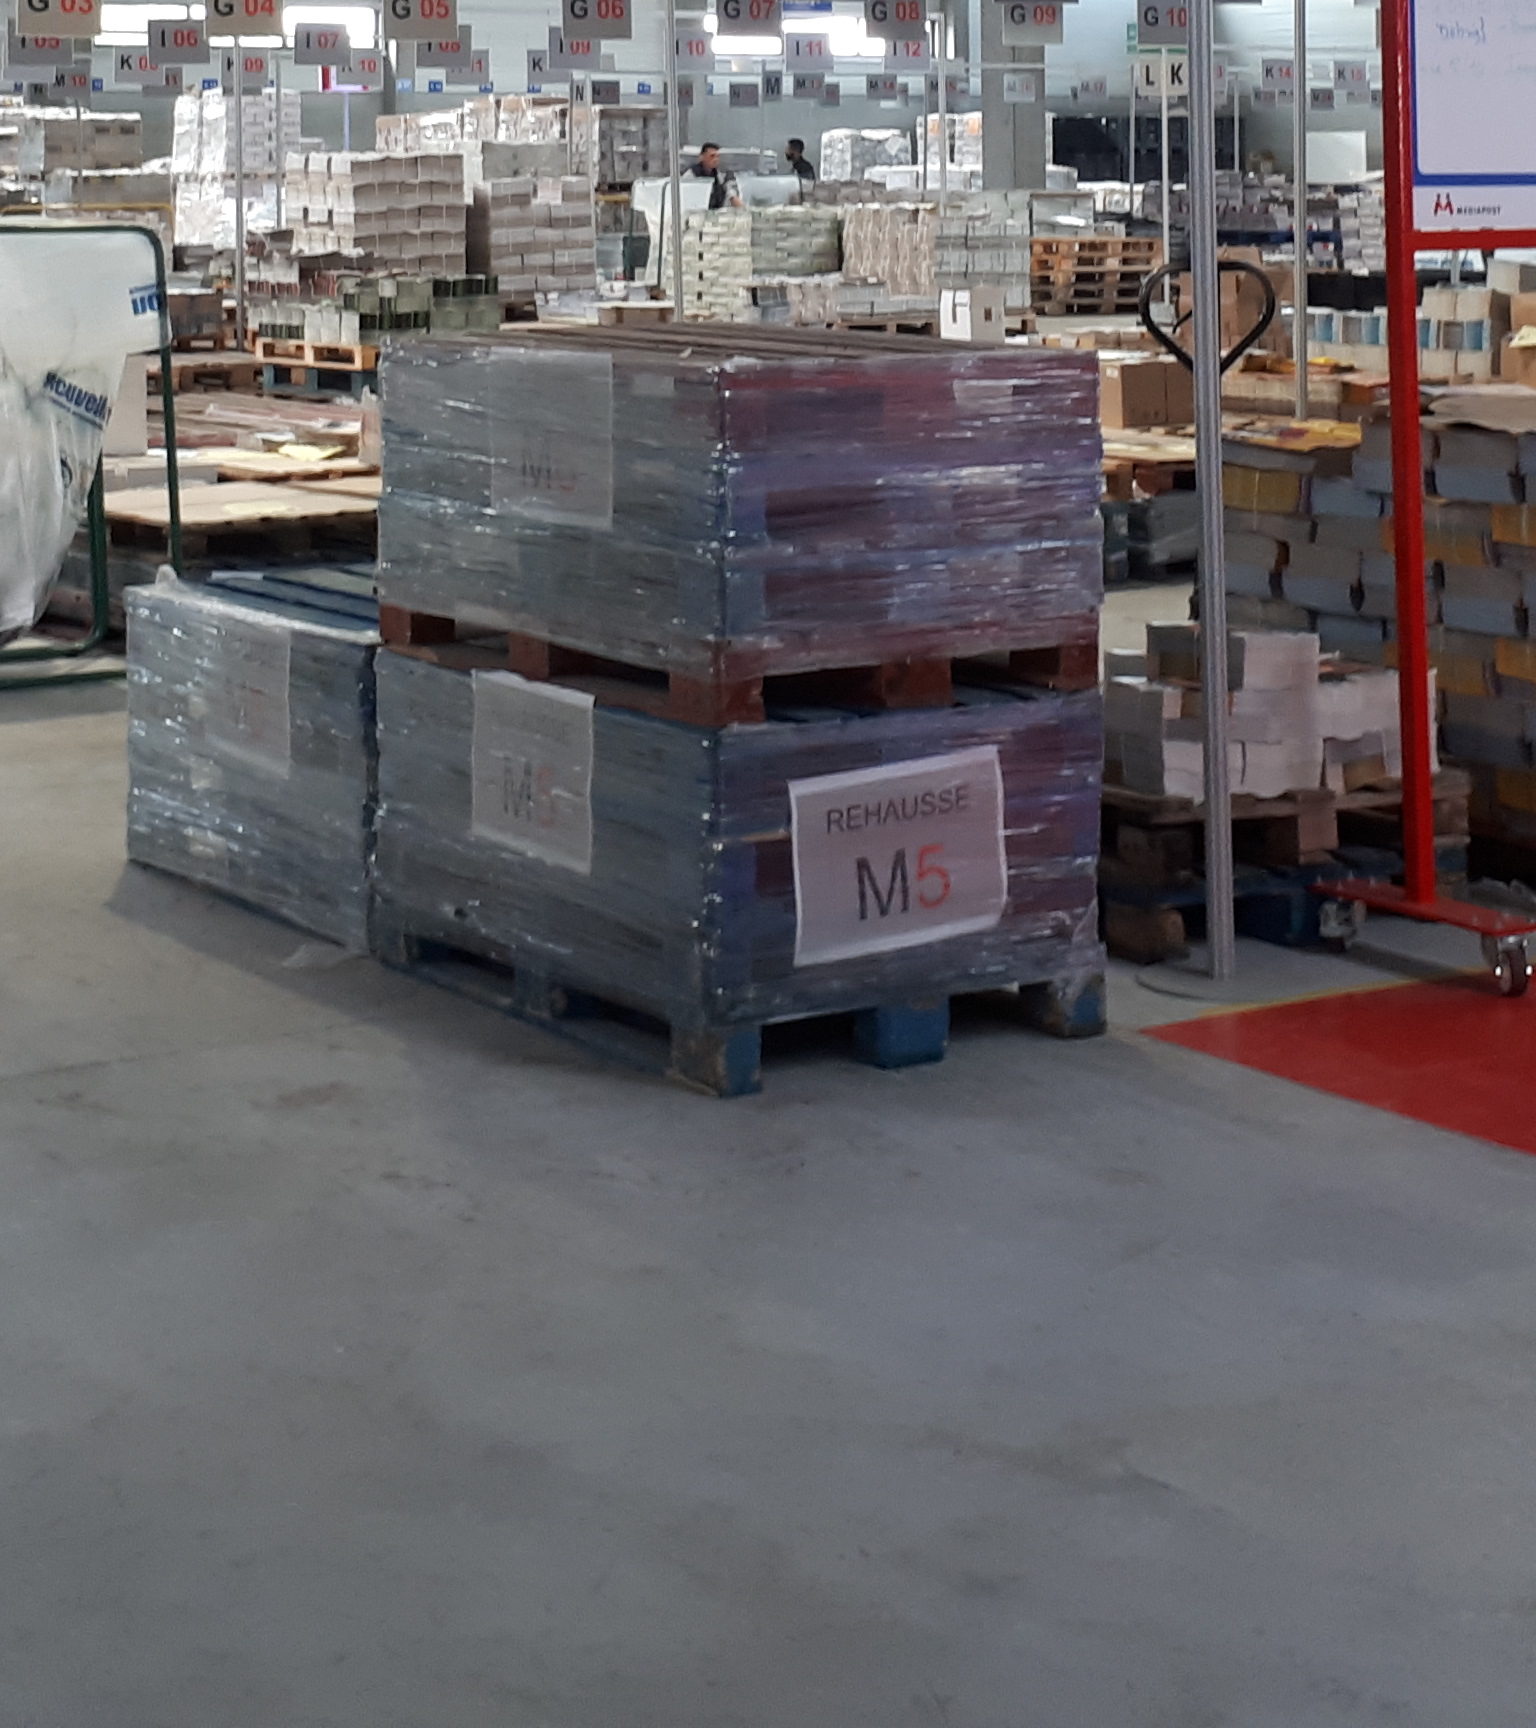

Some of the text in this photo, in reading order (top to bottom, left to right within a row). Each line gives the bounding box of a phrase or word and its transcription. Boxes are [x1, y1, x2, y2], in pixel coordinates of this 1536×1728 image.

[871, 0, 920, 21] G 08
[1010, 4, 1056, 26] G 09
[1144, 6, 1187, 27] G 10
[160, 29, 198, 47] I 06
[305, 32, 339, 49] I 07
[686, 39, 705, 56] 10
[795, 39, 823, 56] I 11
[893, 40, 921, 57] I 12
[120, 54, 133, 70] K
[243, 56, 264, 72] 09
[532, 56, 543, 72] K
[1145, 64, 1155, 86] L
[1171, 62, 1183, 86] K
[1265, 65, 1275, 79] K
[576, 84, 584, 101] N
[766, 77, 780, 95] M
[825, 784, 972, 834] REHAUSSE
[855, 843, 952, 920] M5
